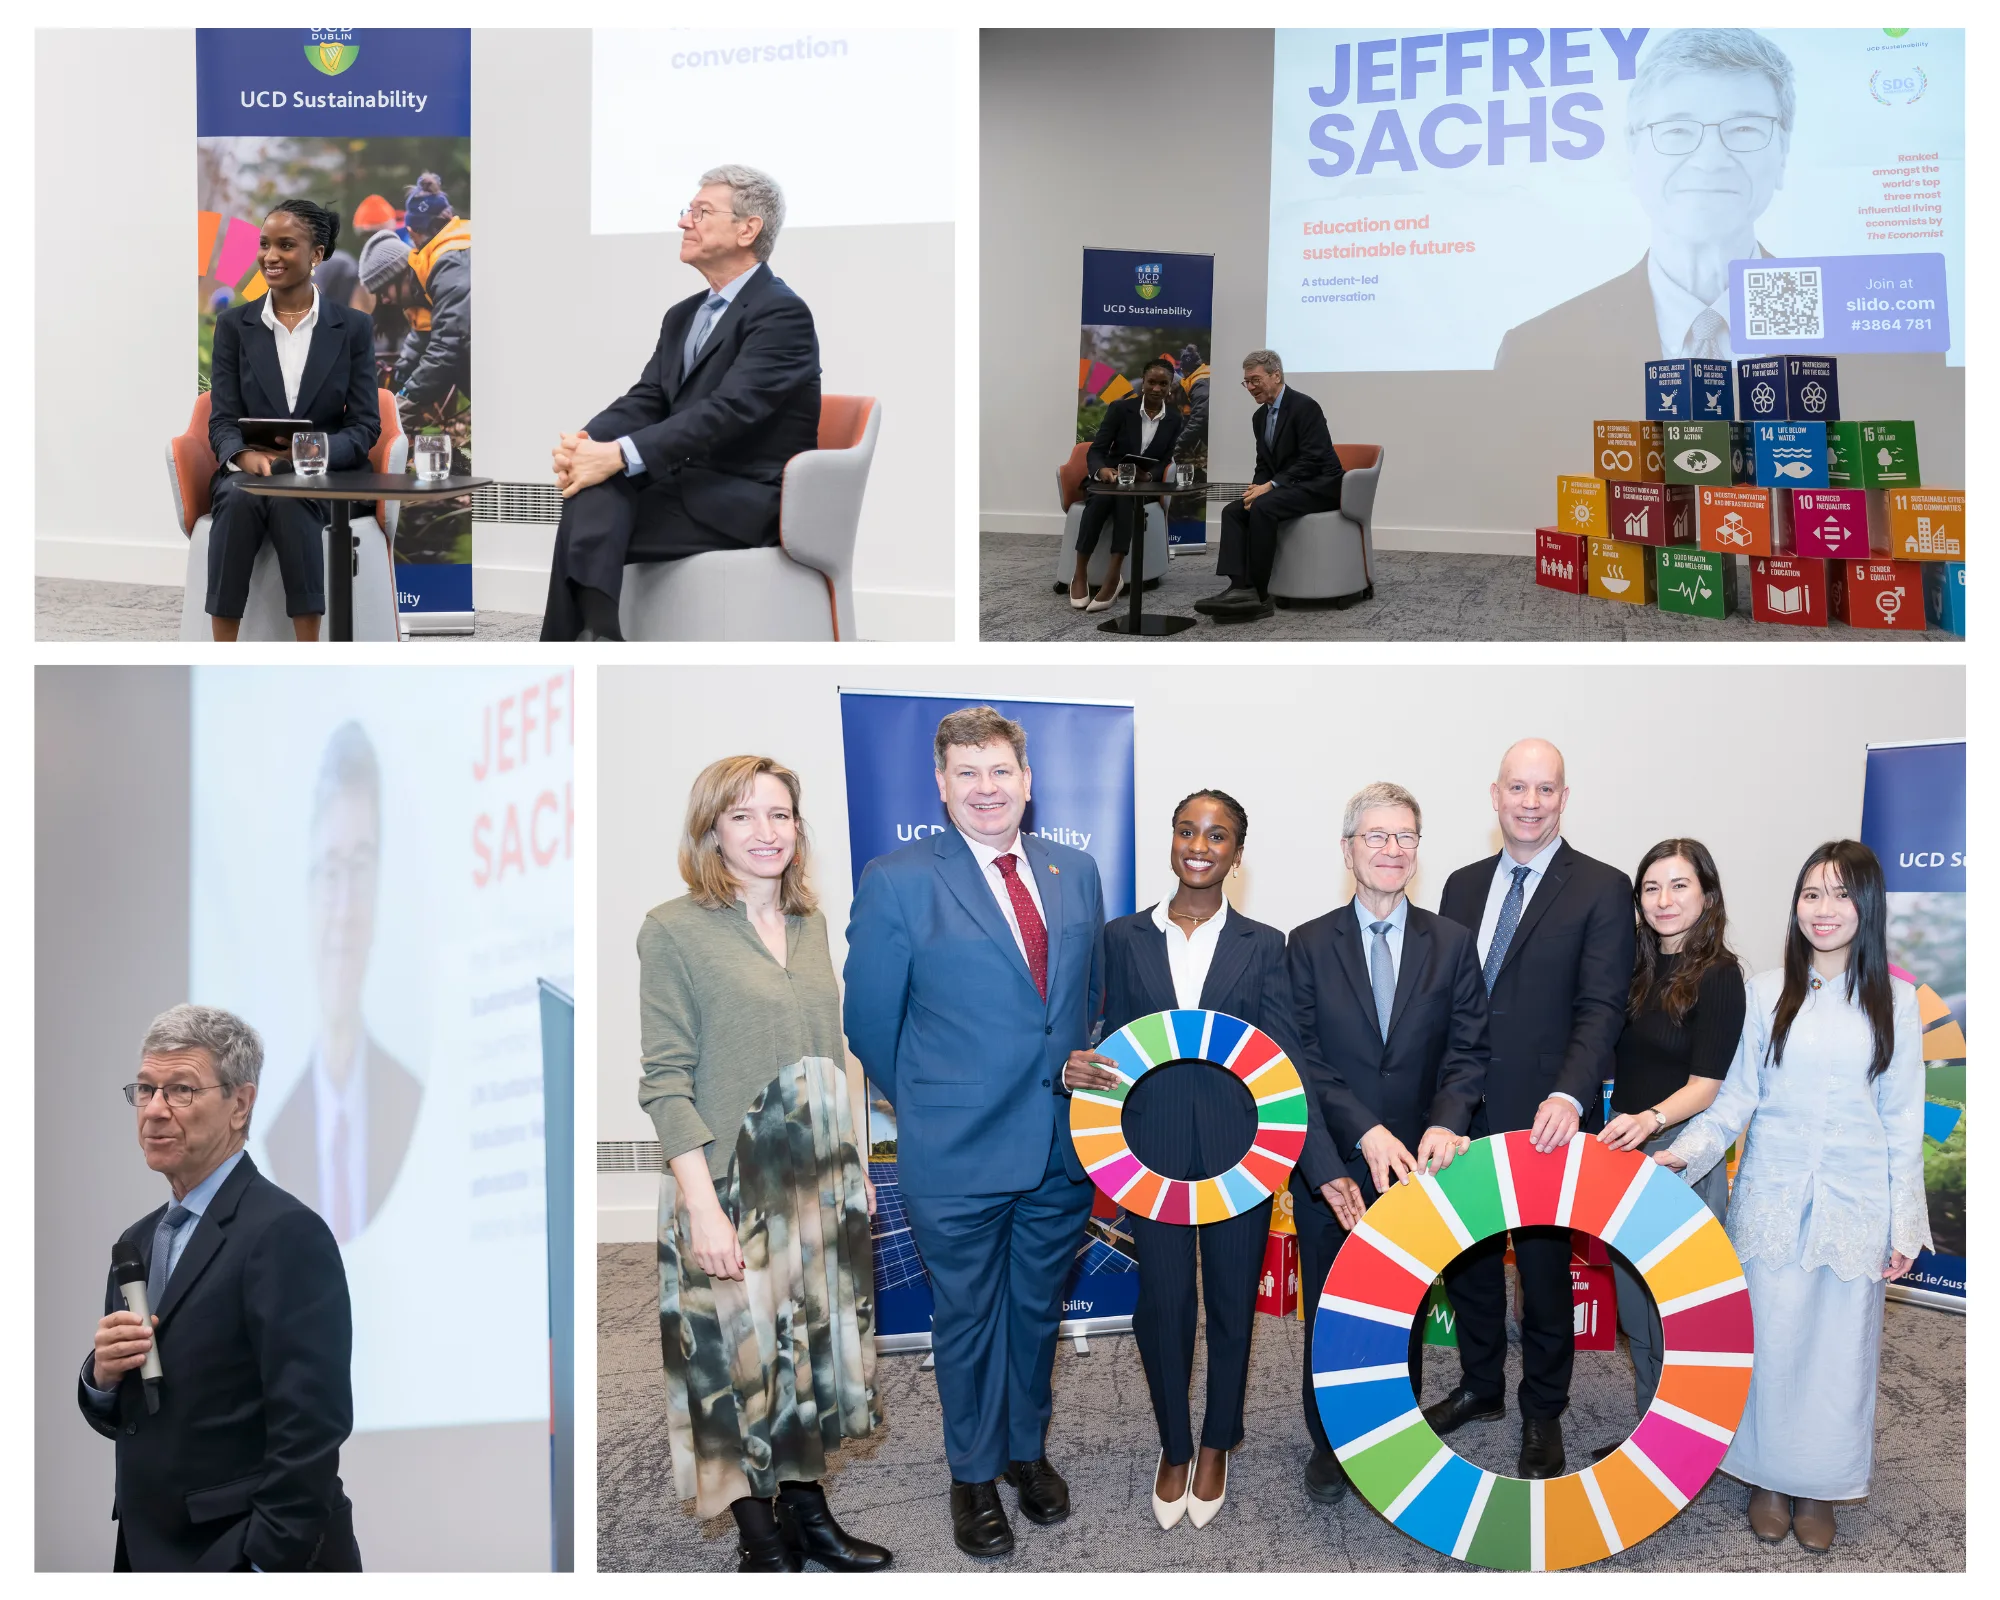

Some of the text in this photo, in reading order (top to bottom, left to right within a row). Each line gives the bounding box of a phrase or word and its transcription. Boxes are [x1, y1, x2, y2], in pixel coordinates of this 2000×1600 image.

[671, 35, 848, 69] conversation
[1308, 28, 1651, 107] JEFFREY
[1882, 77, 1914, 91] SDG
[240, 90, 428, 112] UCD Sustainability
[1308, 92, 1606, 178] SACHS
[1898, 152, 1939, 162] Ranked
[1872, 164, 1940, 176] amongst the
[1922, 178, 1940, 188] top
[1884, 191, 1942, 200] three most
[1858, 204, 1942, 215] influential living
[1303, 214, 1430, 236] Education and
[1865, 216, 1943, 228] economists by
[1867, 229, 1944, 240] The Economist
[1302, 240, 1476, 261] sustainable futures
[1138, 272, 1160, 280] UCD
[1301, 274, 1379, 287] A student-led
[1865, 278, 1914, 290] Join at
[1301, 291, 1376, 304] conversation
[1846, 297, 1935, 312] slido.com
[1103, 304, 1193, 317] UCD Sustainability
[1851, 319, 1932, 331] #3864 781
[1648, 366, 1658, 380] 16
[1693, 364, 1702, 378] 16
[1742, 364, 1750, 378] 17
[1790, 361, 1800, 376] 17
[1597, 425, 1605, 438] 12
[1642, 426, 1650, 439] 12
[1668, 426, 1680, 440] 13
[1760, 427, 1774, 441] 14
[1863, 427, 1875, 442] 15
[1562, 480, 1567, 493] 7
[1614, 485, 1621, 499] 8
[1704, 491, 1712, 505] 9
[1798, 495, 1813, 510] 10
[1895, 495, 1908, 510] 11
[1540, 534, 1544, 547] 1
[1592, 543, 1598, 556] 2
[1662, 553, 1670, 567] 3
[1770, 560, 1792, 569] QUALITY
[1757, 560, 1765, 575] 4
[1770, 569, 1800, 577] EDUCATION
[1856, 565, 1865, 581] 5
[1957, 570, 1965, 586] 6
[472, 667, 574, 782] JEFF
[1899, 852, 1945, 868] UCD
[1603, 1090, 1613, 1098] LO
[1288, 1240, 1292, 1258] 1
